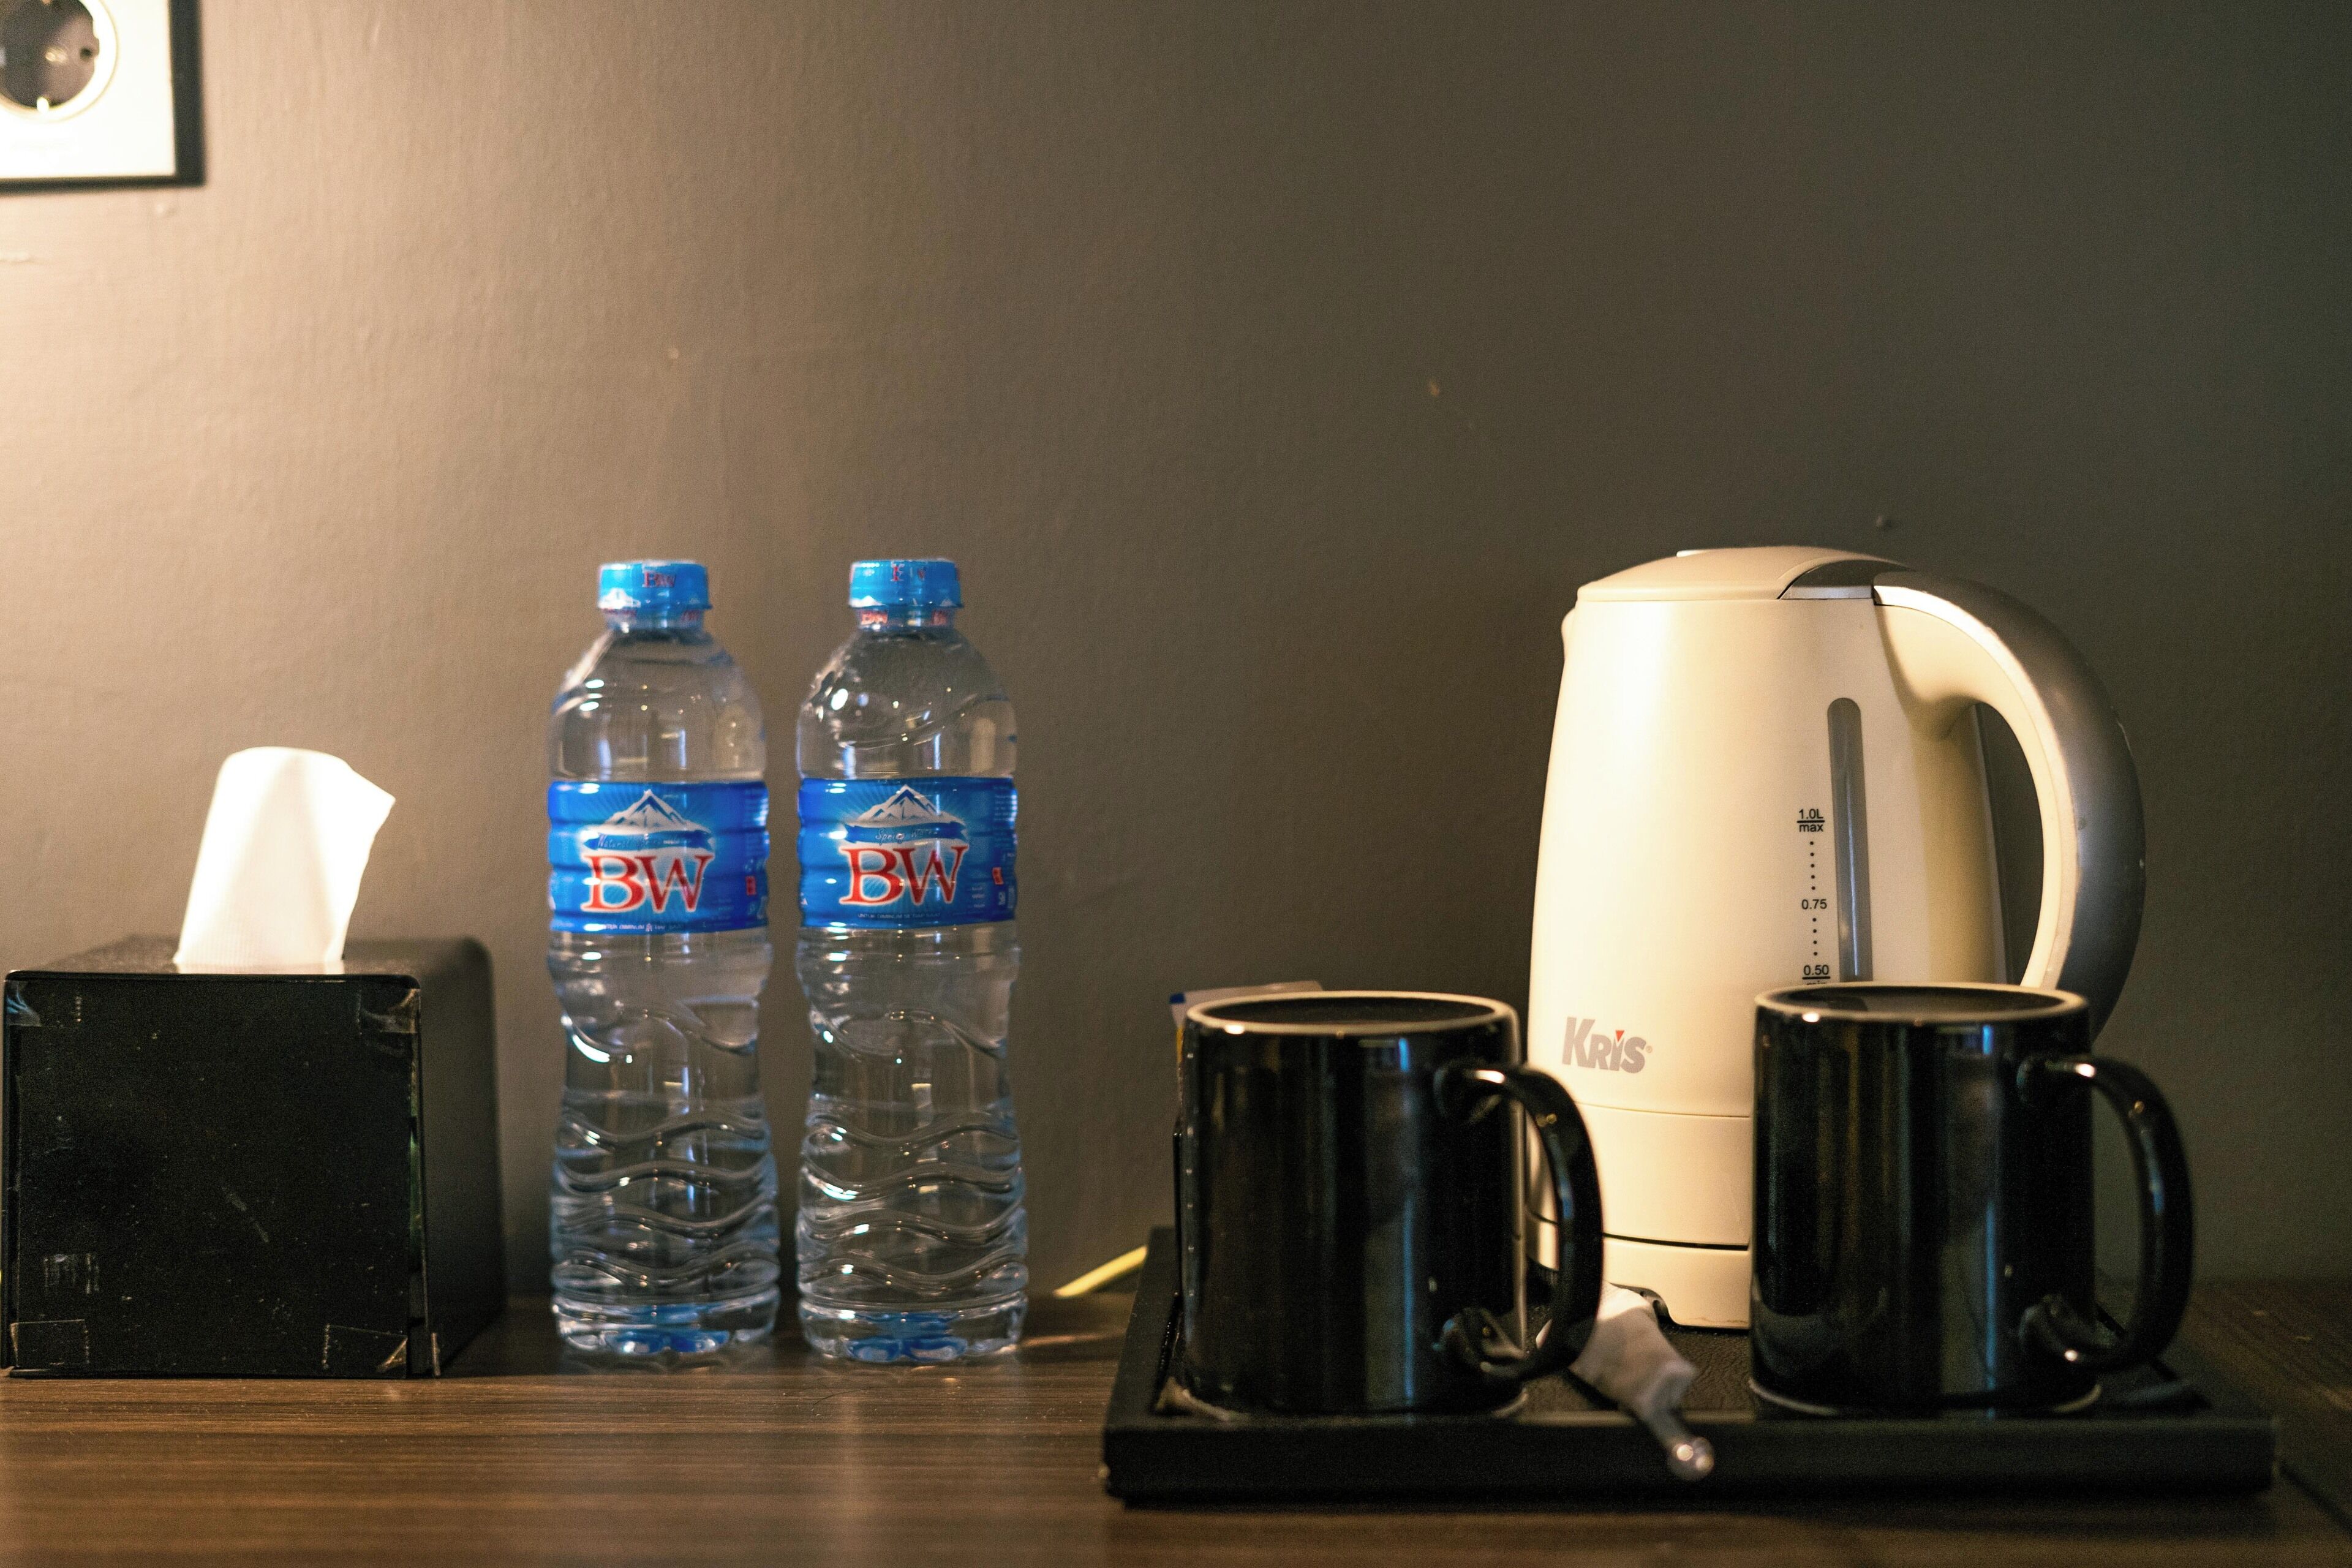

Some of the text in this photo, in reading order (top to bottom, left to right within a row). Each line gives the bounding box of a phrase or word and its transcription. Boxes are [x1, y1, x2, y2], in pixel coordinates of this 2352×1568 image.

[1798, 809, 1824, 820] 1.0L
[1799, 823, 1824, 832] max
[839, 845, 969, 906] BW
[580, 854, 715, 913] BW
[1801, 899, 1828, 910] 0.75
[1803, 964, 1830, 976] 0.50
